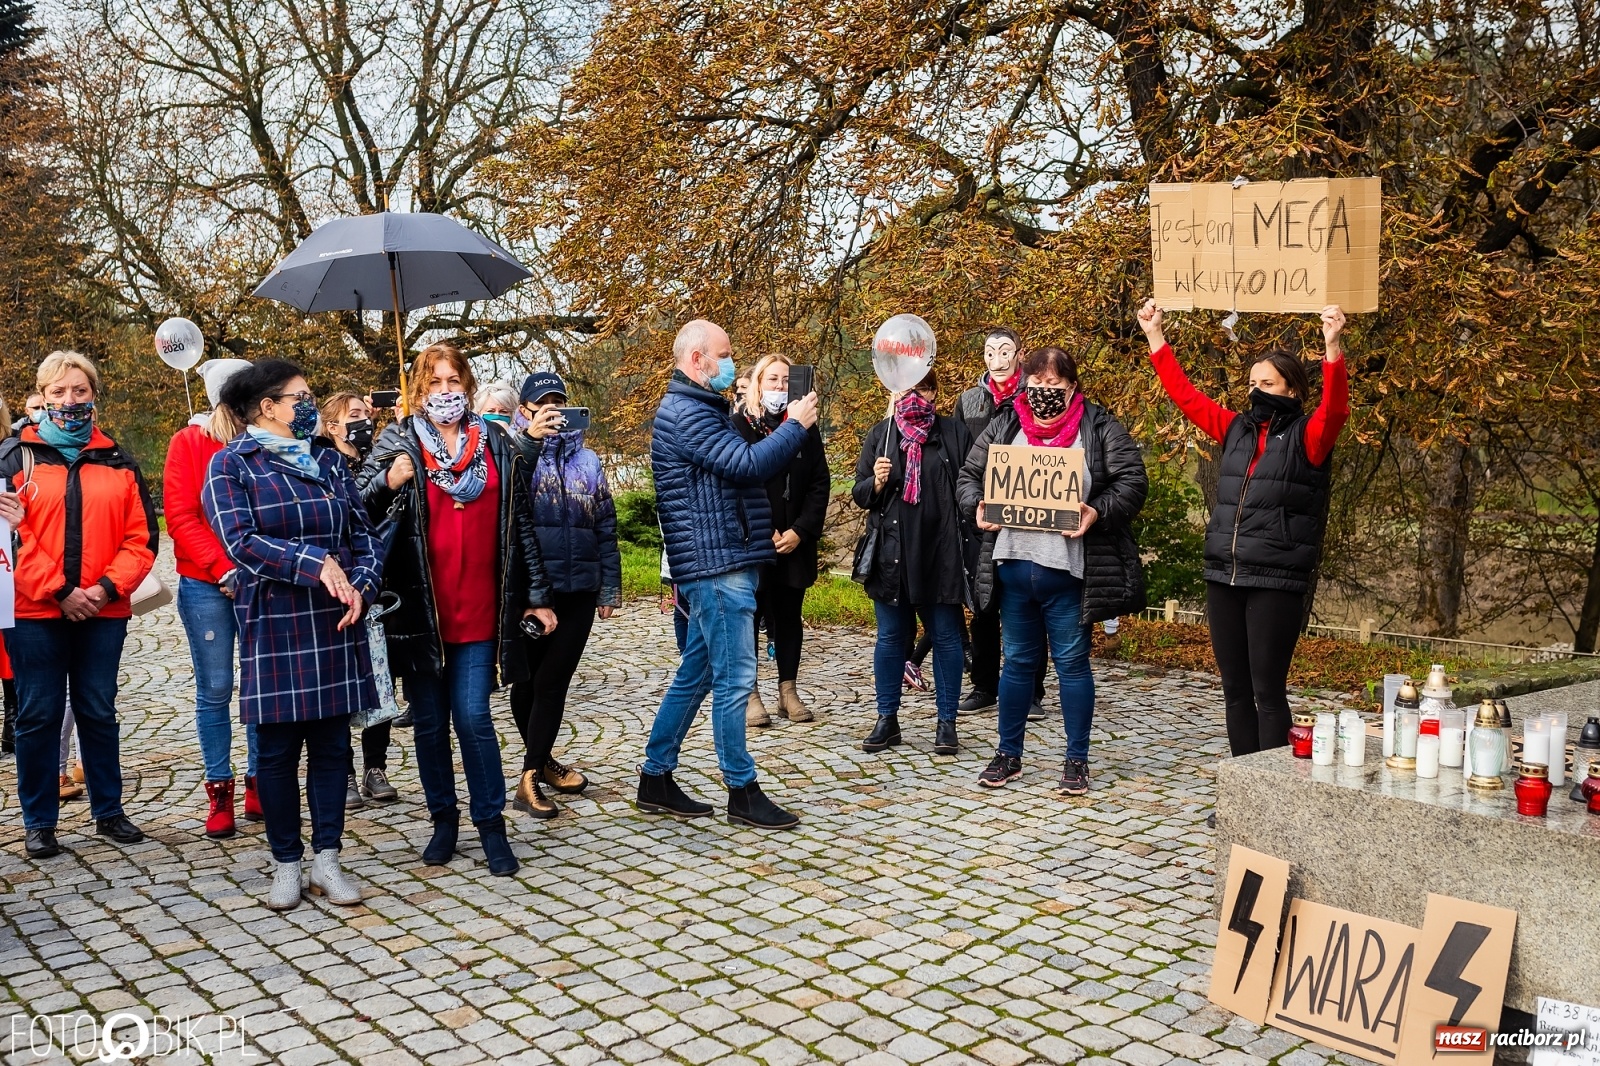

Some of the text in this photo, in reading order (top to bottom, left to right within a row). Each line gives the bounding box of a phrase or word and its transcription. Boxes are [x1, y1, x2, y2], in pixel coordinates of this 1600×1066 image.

[1150, 194, 1350, 262] Jestem MEGA
[162, 342, 185, 354] 2020
[992, 451, 1067, 468] TO MOJA
[1282, 914, 1415, 1044] WARA
[1563, 1004, 1580, 1020] 38
